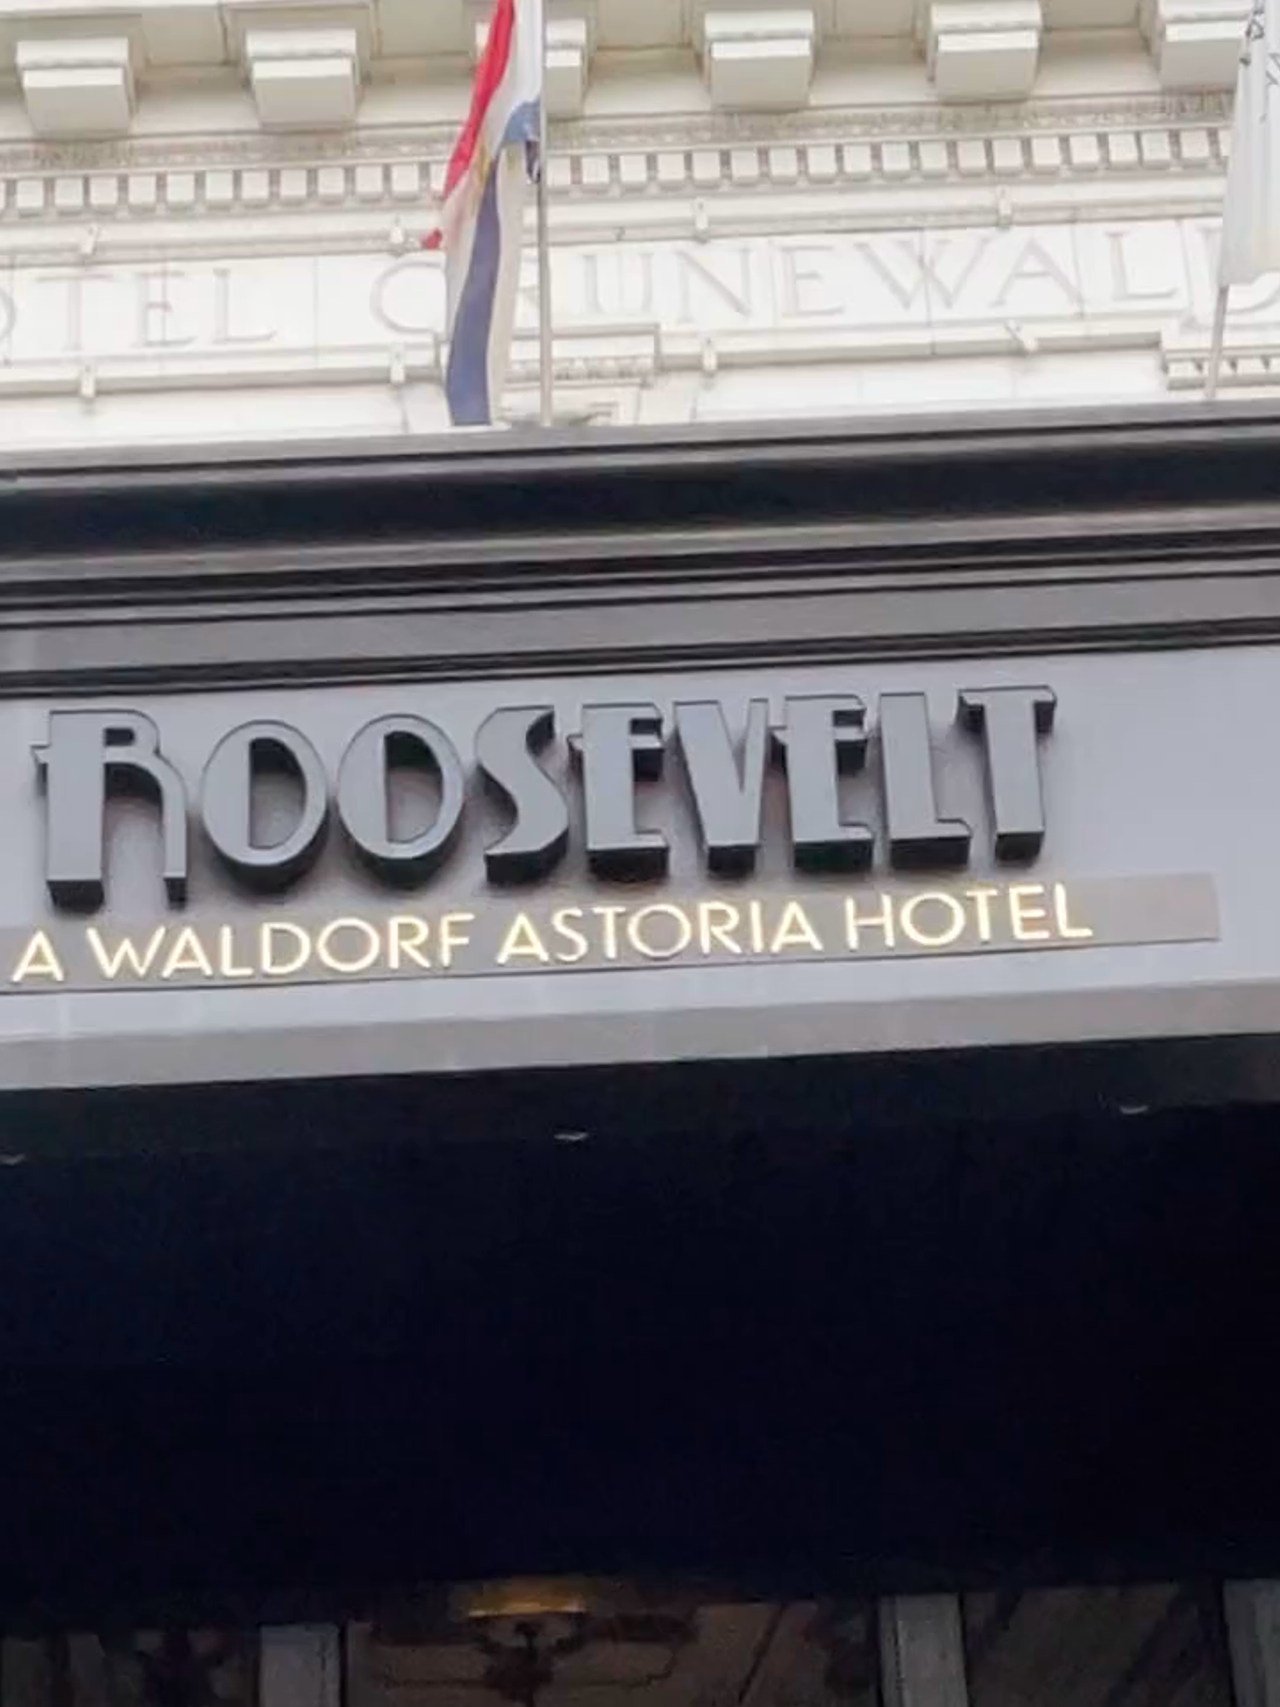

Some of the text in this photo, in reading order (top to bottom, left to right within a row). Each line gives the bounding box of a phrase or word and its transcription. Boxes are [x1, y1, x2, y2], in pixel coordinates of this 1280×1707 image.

[32, 685, 1056, 908] ROOSEVELT
[9, 883, 1094, 983] A WALDORF ASTORIA HOTEL
